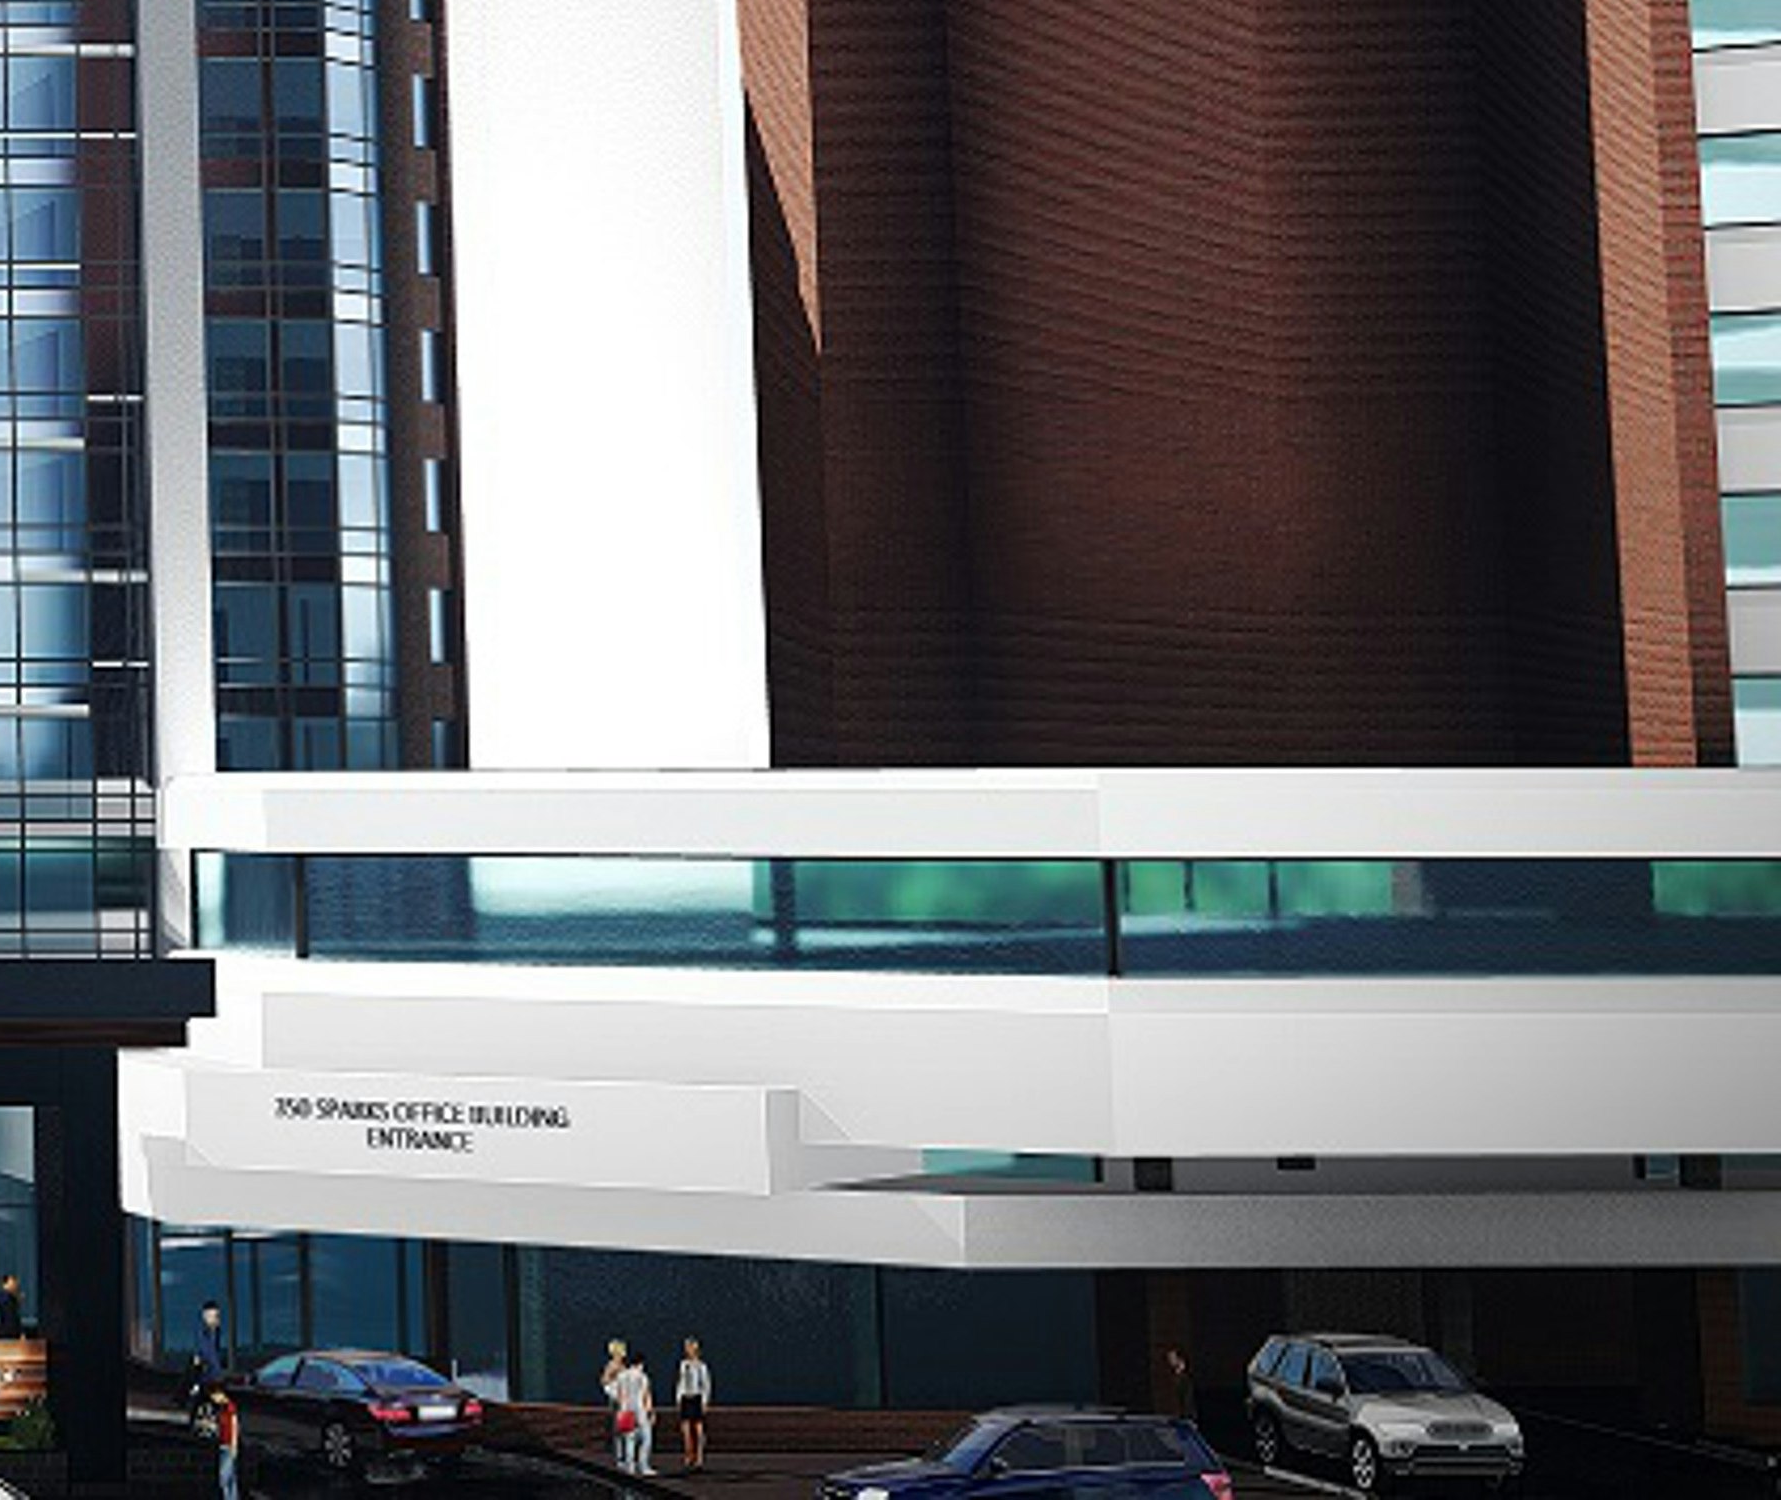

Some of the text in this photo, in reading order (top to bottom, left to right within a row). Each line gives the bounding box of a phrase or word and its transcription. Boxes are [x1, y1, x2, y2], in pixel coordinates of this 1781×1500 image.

[315, 1097, 390, 1122] SPARKS
[392, 1101, 465, 1124] OFFICE
[468, 1104, 571, 1129] BUILDING
[366, 1127, 474, 1153] ENTRANCE
